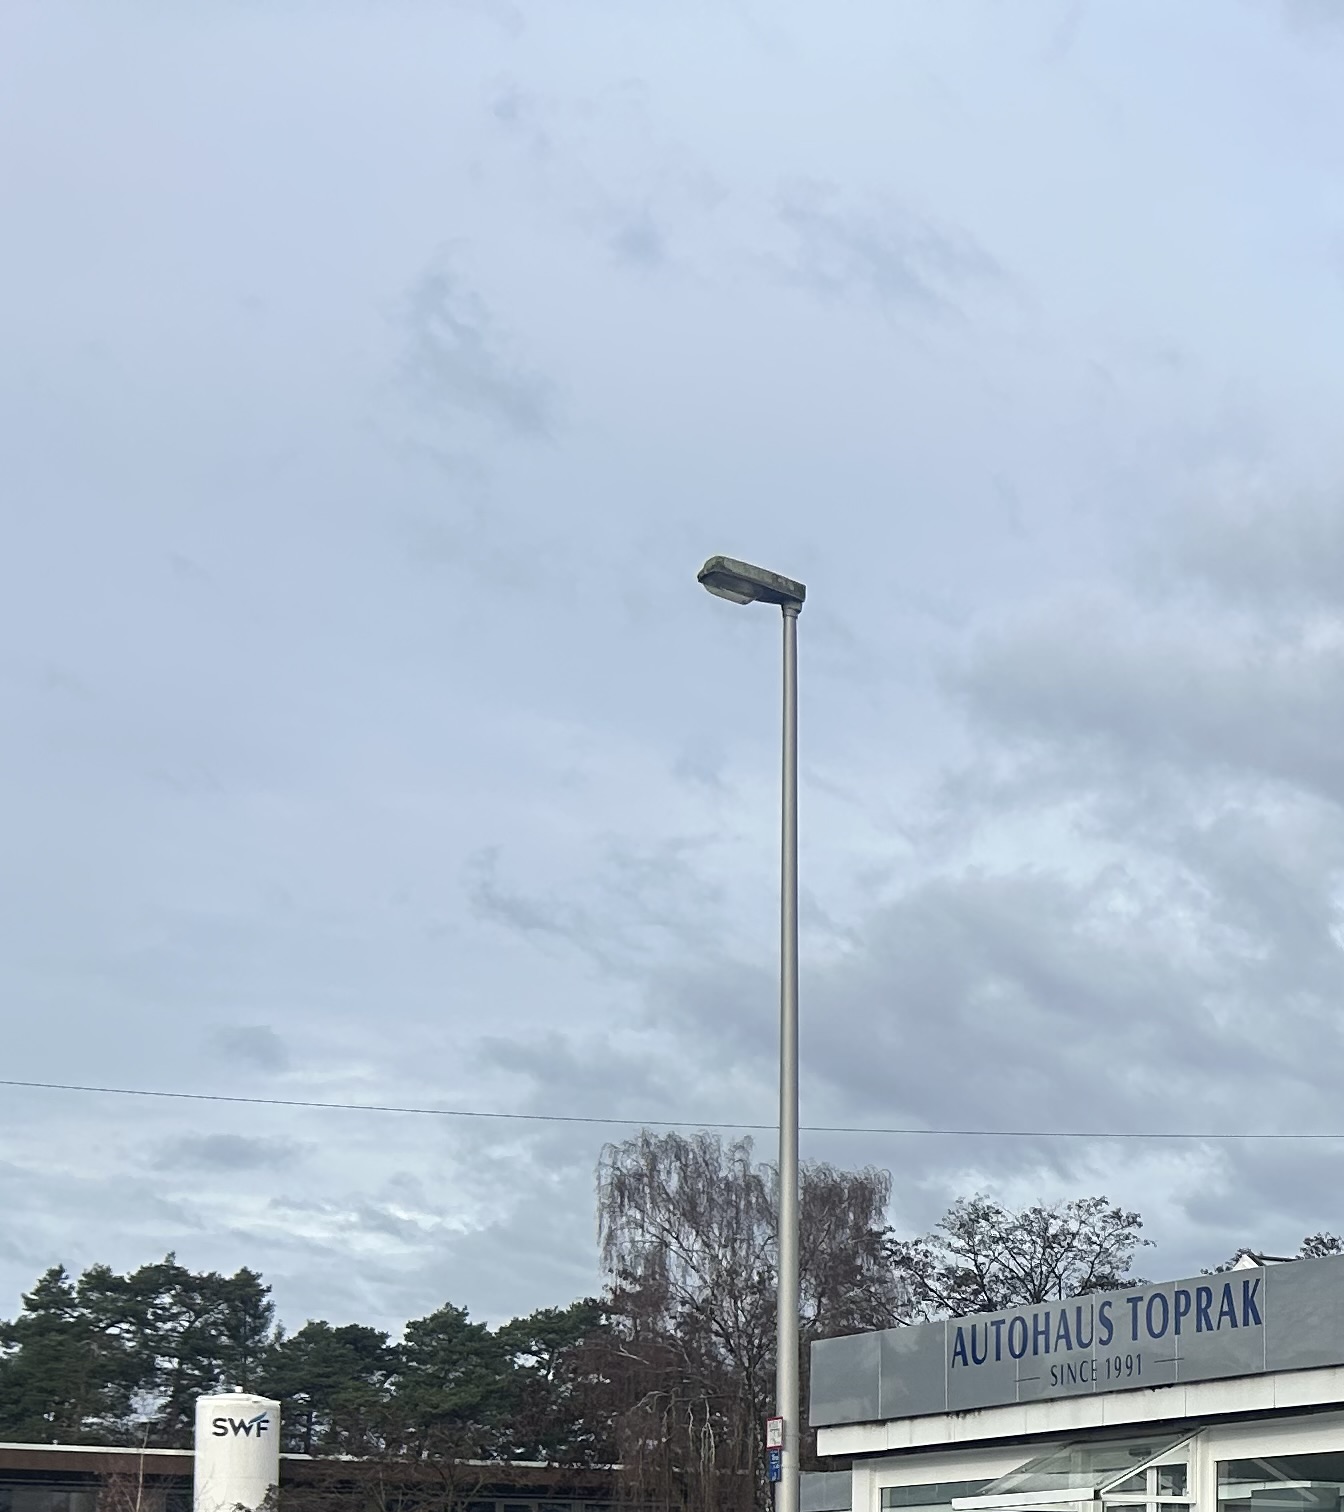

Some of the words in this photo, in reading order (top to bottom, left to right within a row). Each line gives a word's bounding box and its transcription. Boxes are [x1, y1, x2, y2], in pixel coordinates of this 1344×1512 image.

[951, 1301, 1114, 1369] AUTOHAUS
[1126, 1278, 1263, 1341] TOPRAK
[1049, 1360, 1098, 1388] SINCE
[1105, 1353, 1144, 1381] 1991
[212, 1413, 269, 1437] SWF
